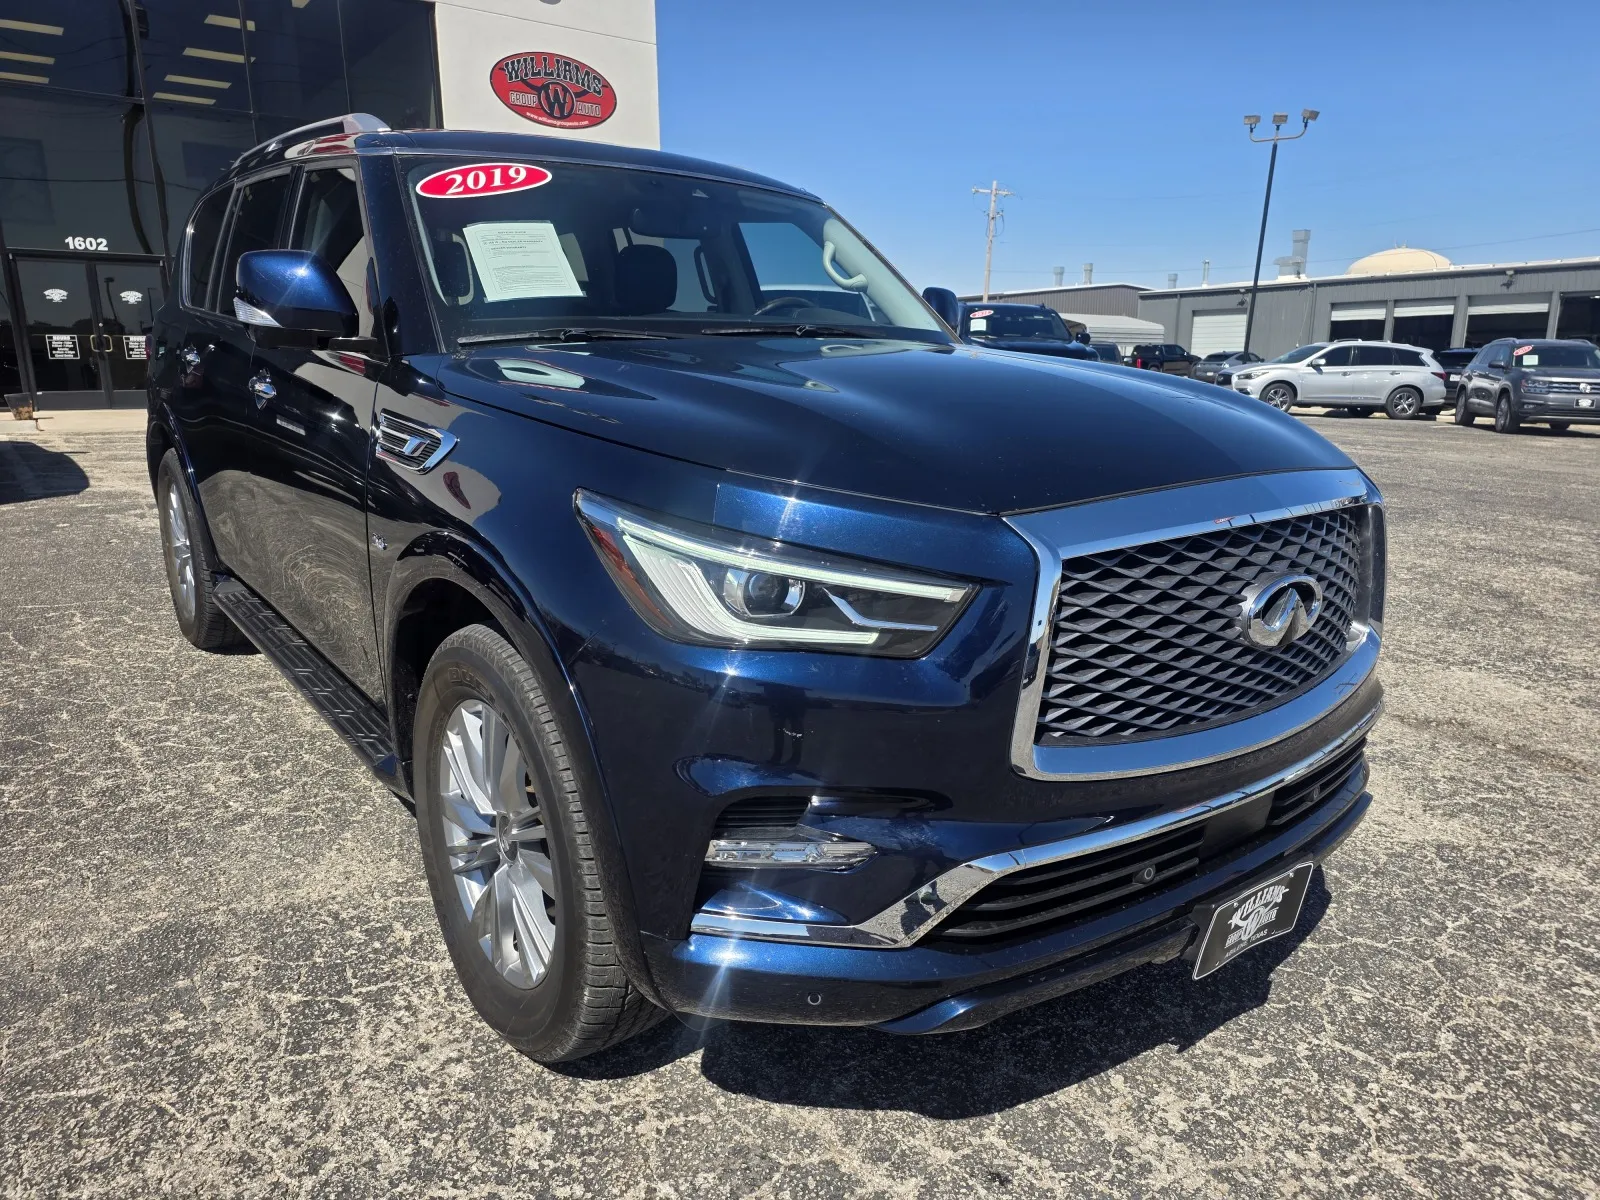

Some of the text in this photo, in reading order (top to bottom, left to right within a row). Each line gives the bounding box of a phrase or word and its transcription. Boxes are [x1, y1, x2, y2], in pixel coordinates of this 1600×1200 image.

[504, 56, 603, 97] WILLIAMS
[510, 92, 538, 107] GROUP
[577, 102, 601, 117] AUTO
[445, 166, 527, 194] 2019
[65, 236, 108, 250] 1602
